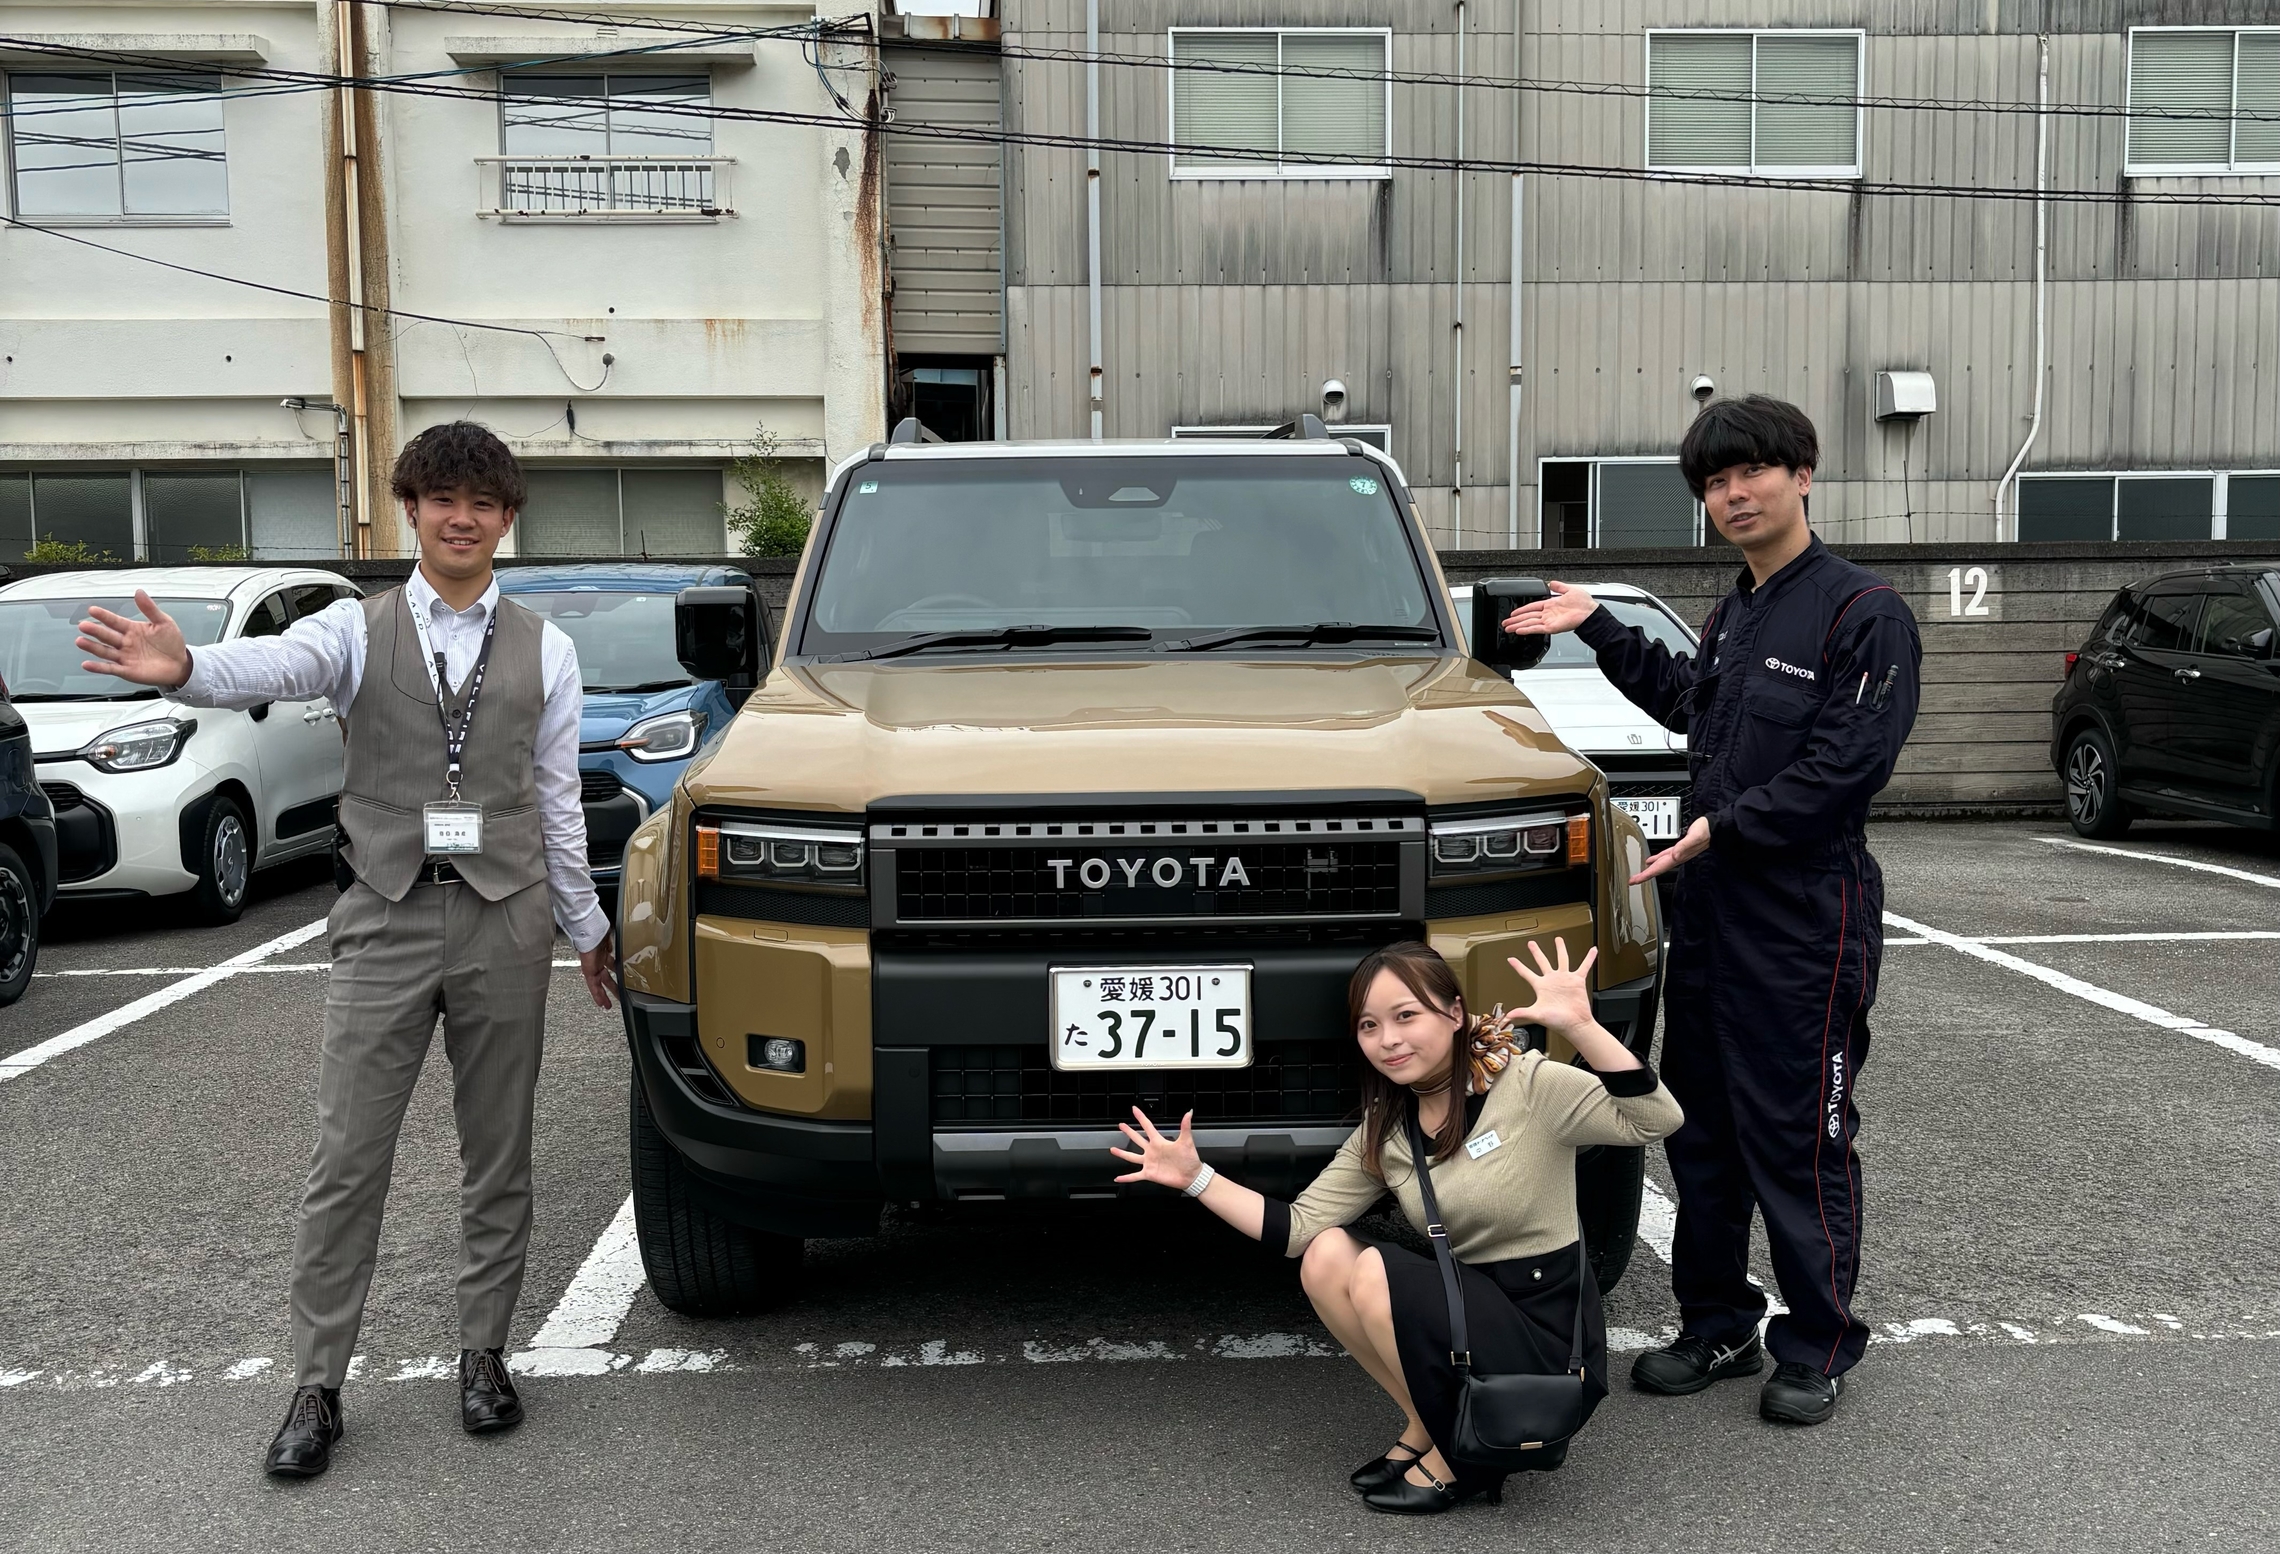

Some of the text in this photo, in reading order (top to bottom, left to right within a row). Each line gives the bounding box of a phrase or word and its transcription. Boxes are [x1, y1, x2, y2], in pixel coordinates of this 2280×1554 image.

[1947, 566, 1989, 616] 12
[1781, 662, 1815, 681] TOYOTA
[1047, 856, 1251, 889] TOYOTA
[1064, 1008, 1241, 1059] た 37-15
[1828, 1051, 1844, 1114] TOYOTA
